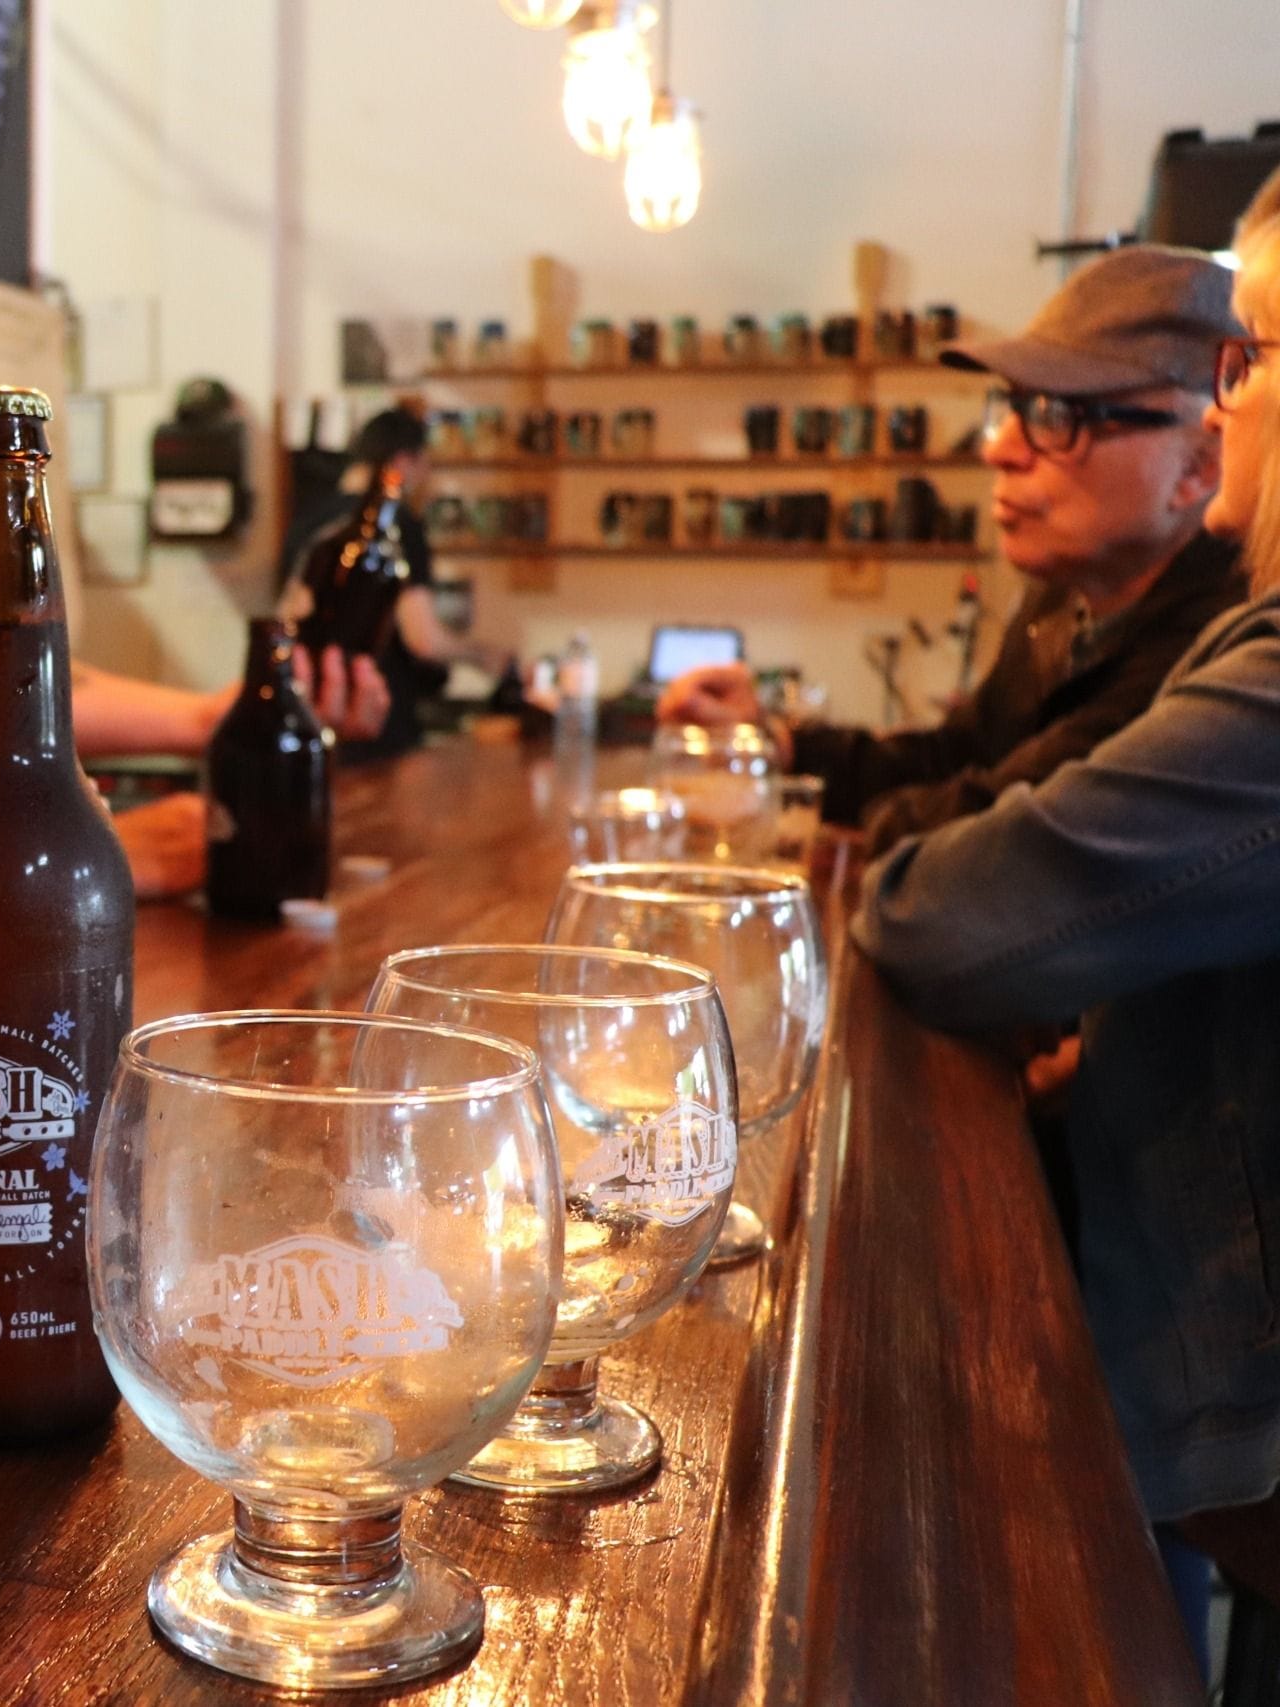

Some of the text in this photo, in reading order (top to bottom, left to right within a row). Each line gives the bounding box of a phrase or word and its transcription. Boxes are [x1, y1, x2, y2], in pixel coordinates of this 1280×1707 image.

[41, 1039, 84, 1083] BATCHES
[627, 1114, 726, 1182] MASH
[22, 1190, 51, 1199] BATCH
[30, 1228, 42, 1237] ON
[4, 1264, 36, 1283] ALL
[217, 1254, 390, 1327] MASH
[10, 1311, 56, 1325] 650ML
[10, 1328, 37, 1339] BEER
[220, 1327, 343, 1354] PADDLE
